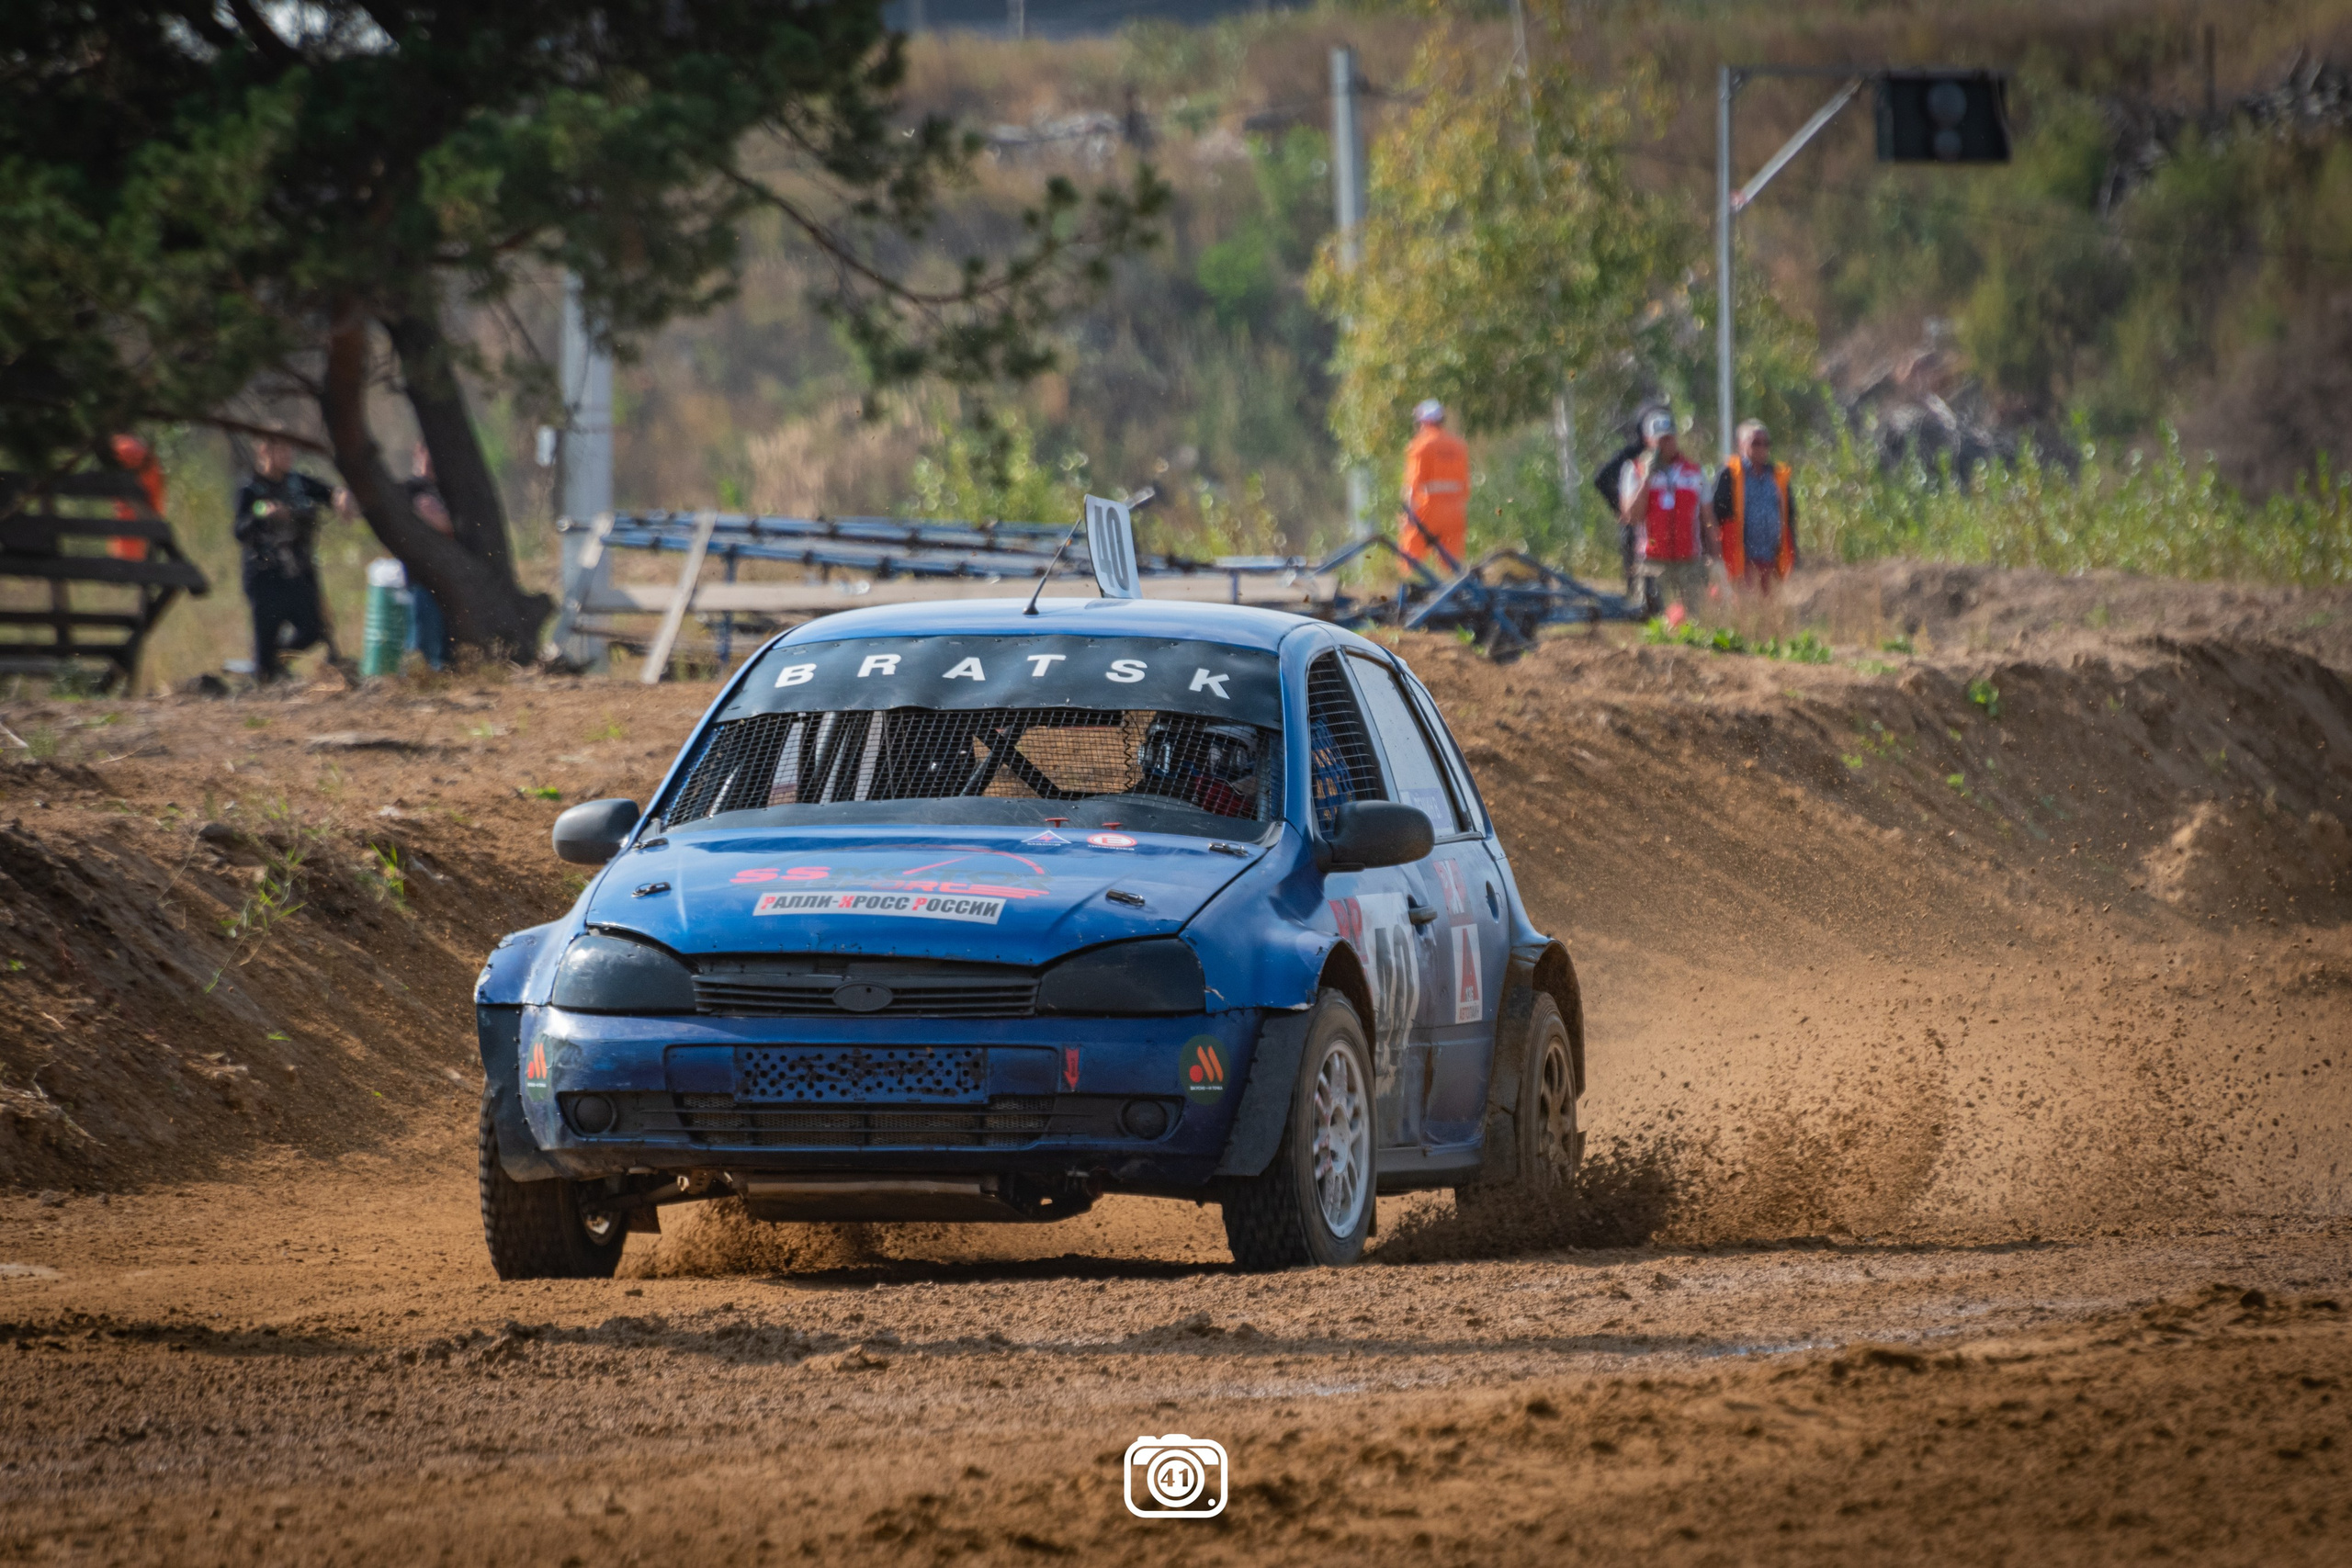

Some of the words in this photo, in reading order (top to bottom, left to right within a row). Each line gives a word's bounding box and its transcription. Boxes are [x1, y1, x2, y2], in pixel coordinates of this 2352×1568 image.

[1093, 504, 1130, 592] 40
[774, 653, 1231, 700] BRATSK
[761, 895, 910, 911] РАЛЛИ-КРОСС
[911, 897, 1001, 918] РОССИИ
